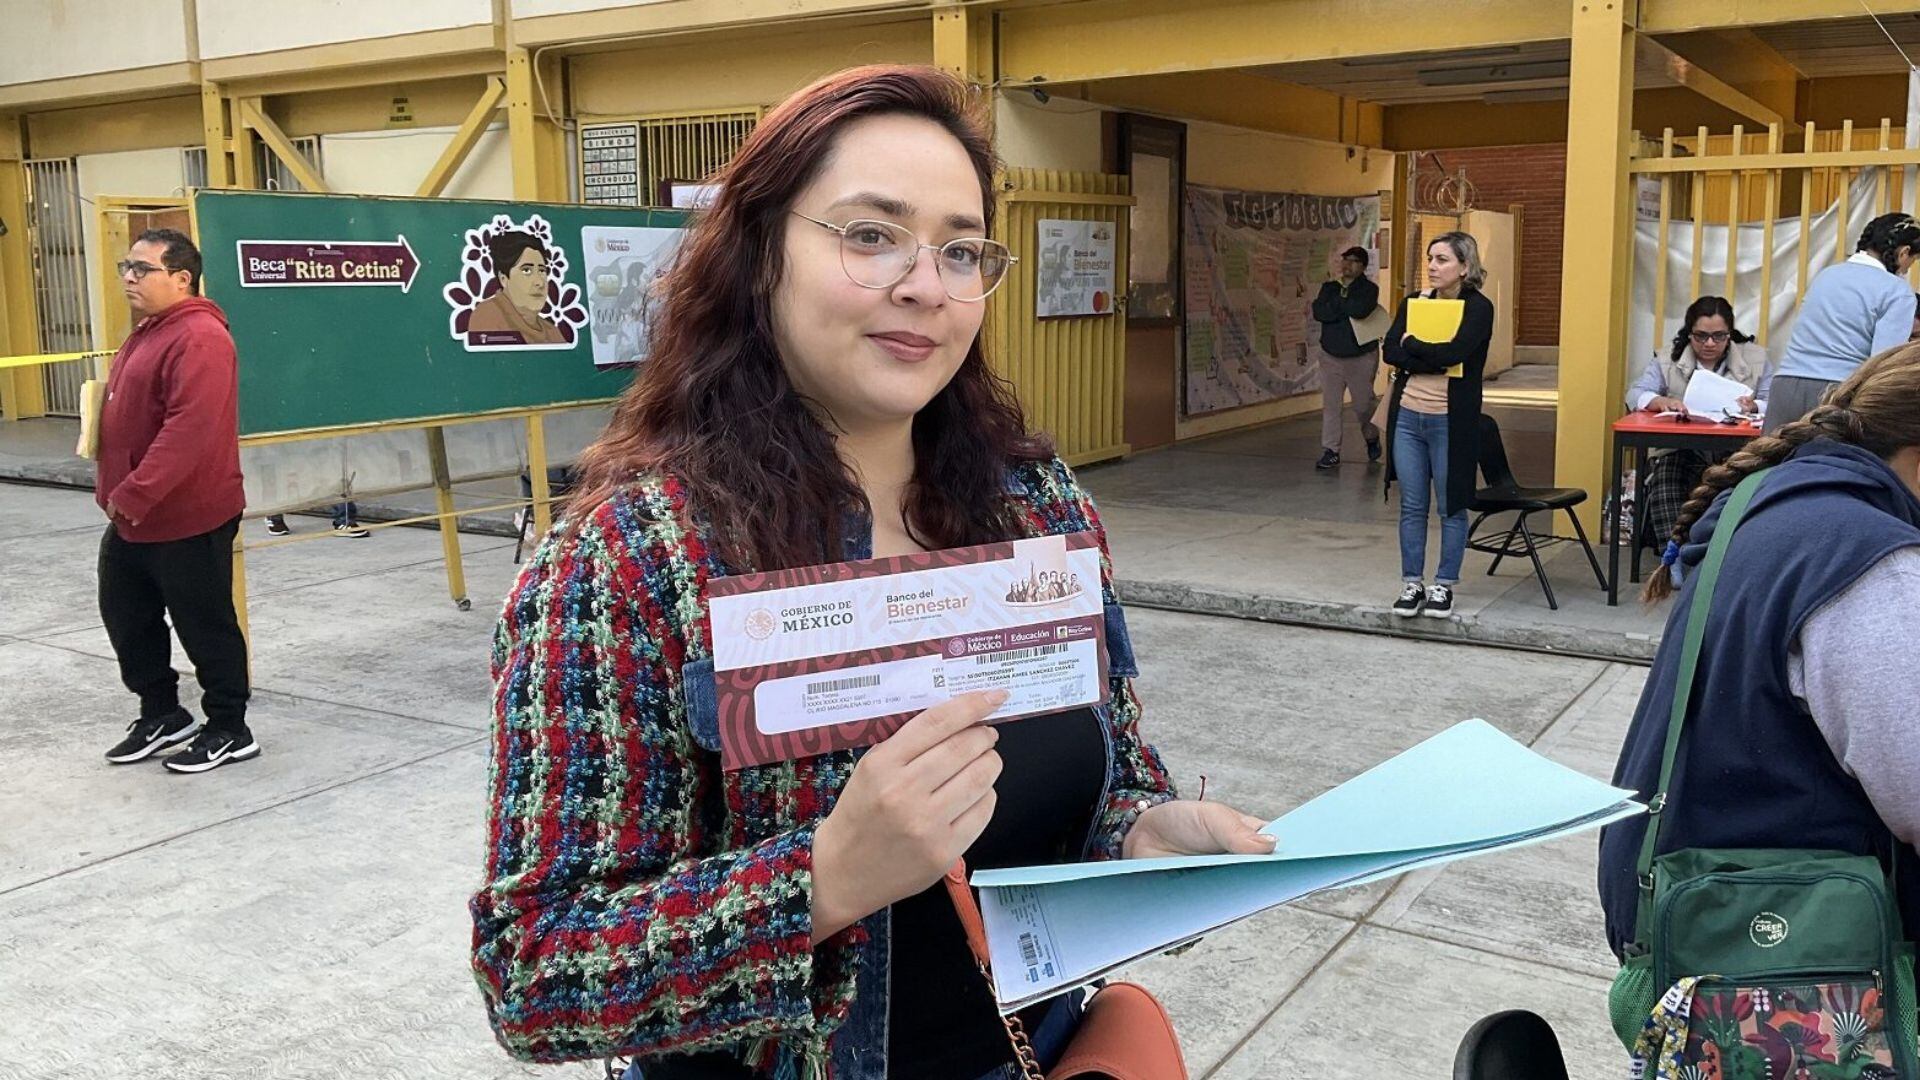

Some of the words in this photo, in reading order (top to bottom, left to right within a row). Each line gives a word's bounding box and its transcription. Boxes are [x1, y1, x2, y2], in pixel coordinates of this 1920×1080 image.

[587, 175, 634, 184] INCENDIOS
[248, 257, 286, 272] Beca
[250, 272, 286, 280] Universal
[886, 592, 917, 603] Banco
[919, 589, 934, 598] del
[781, 602, 837, 618] GOBIERNO
[838, 600, 852, 610] DE
[887, 596, 968, 618] Bienestar
[782, 612, 854, 633] MÉXICO
[1010, 631, 1050, 642] Educación
[968, 640, 1002, 652] México
